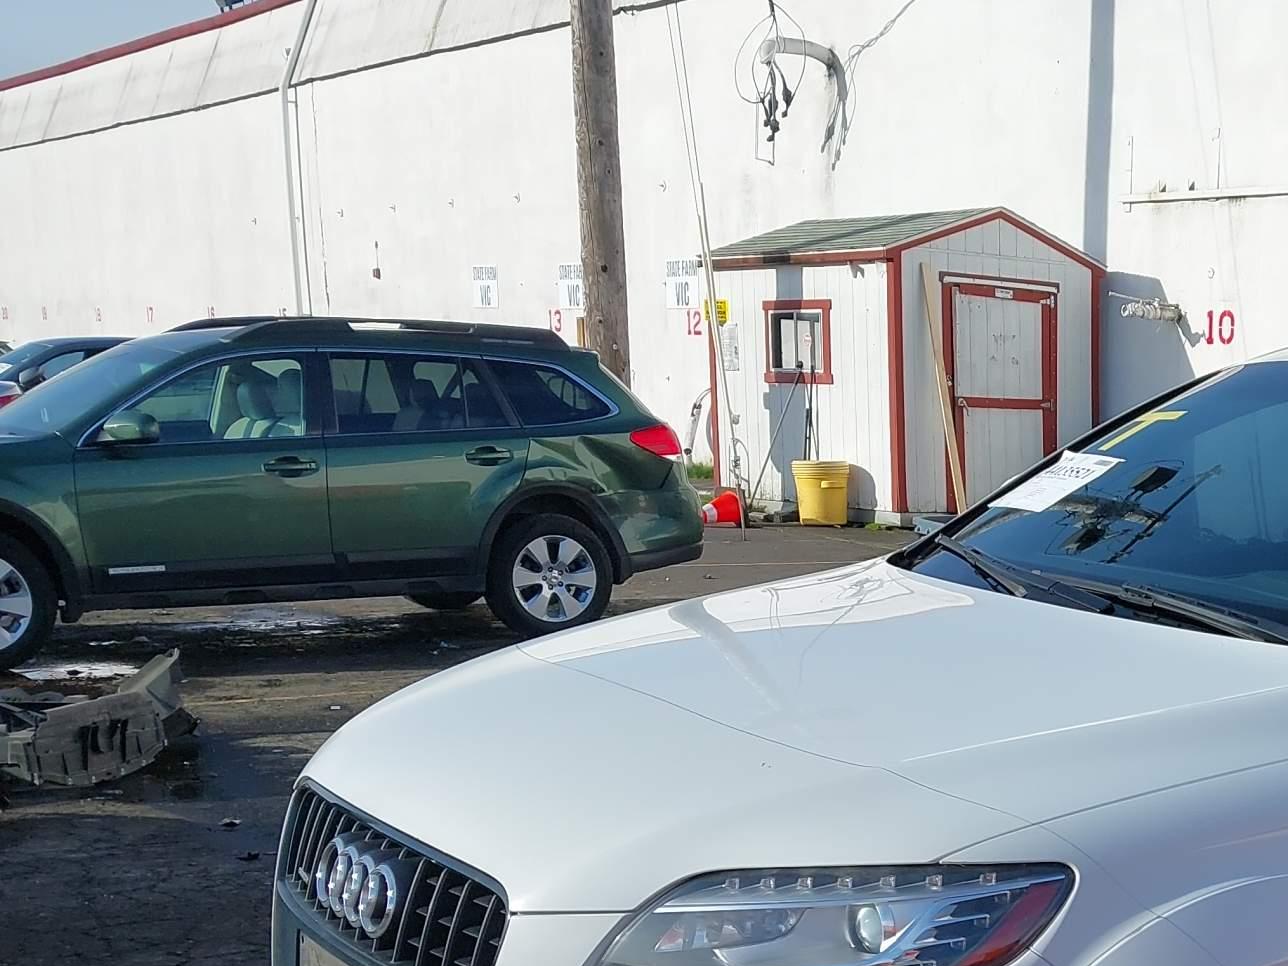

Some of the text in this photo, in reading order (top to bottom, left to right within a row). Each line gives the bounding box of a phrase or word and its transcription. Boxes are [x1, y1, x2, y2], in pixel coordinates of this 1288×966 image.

[473, 267, 497, 280] STATE FARM
[559, 265, 573, 280] STATE
[667, 261, 680, 277] STATE
[480, 285, 491, 306] VIC
[568, 284, 580, 306] VIC
[675, 281, 690, 306] VIC
[549, 309, 561, 332] 13
[687, 310, 702, 335] 12
[1206, 310, 1235, 345] 10
